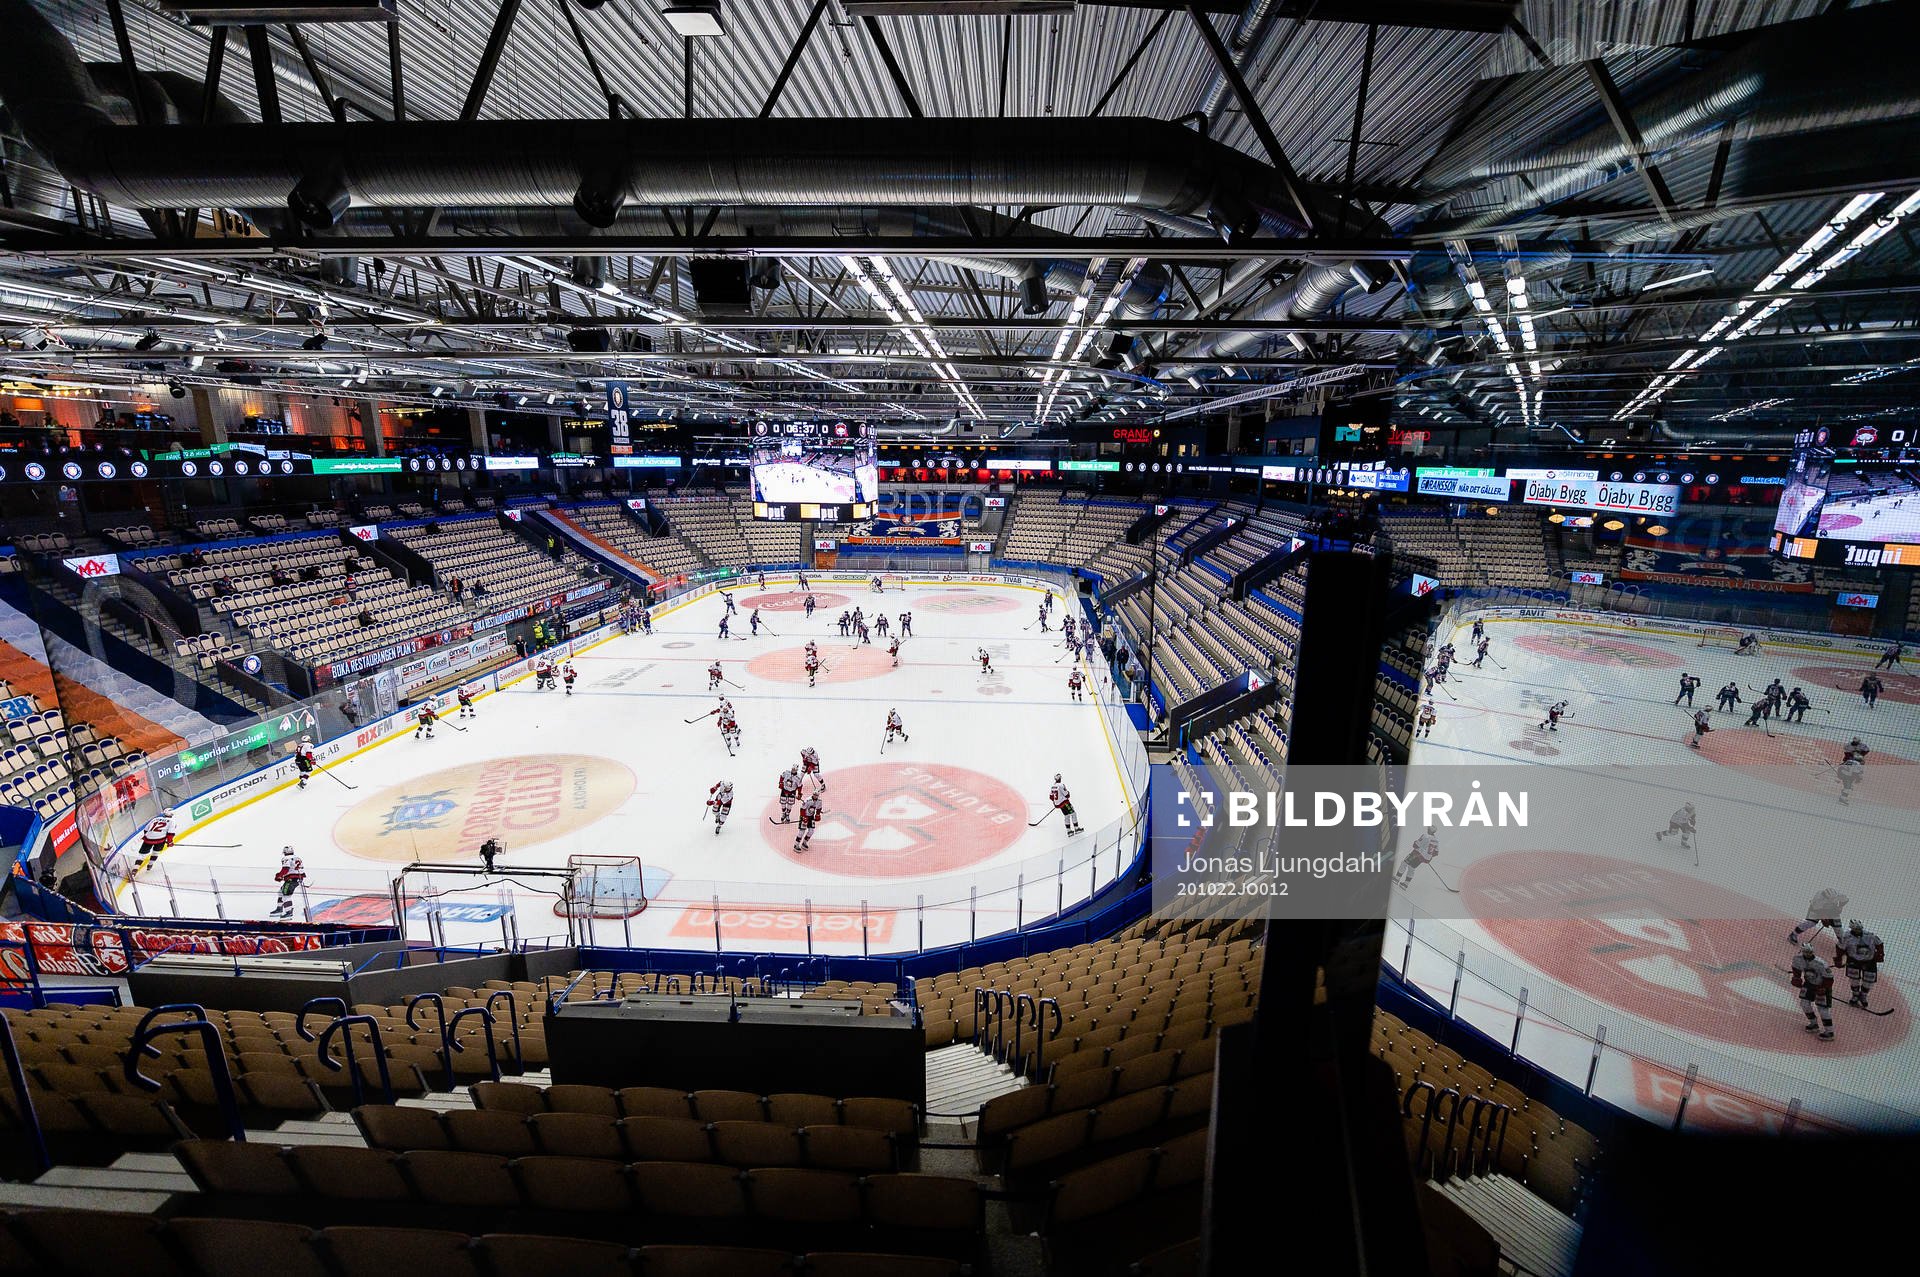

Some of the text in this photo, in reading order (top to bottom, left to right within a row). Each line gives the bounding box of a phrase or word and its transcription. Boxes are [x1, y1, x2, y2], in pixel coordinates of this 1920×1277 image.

[611, 409, 629, 437] 38
[773, 425, 780, 433] 0
[822, 425, 829, 433] 0
[1113, 429, 1150, 439] GRAND
[1458, 484, 1470, 493] NÄR
[1529, 481, 1587, 504] Öjaby Bygg
[1598, 484, 1675, 513] Öjaby Bygg
[79, 560, 108, 578] MAX
[1003, 576, 1022, 584] TIVAB
[332, 660, 350, 680] BOKA
[350, 647, 396, 673] RESTAURANGEN
[396, 643, 411, 658] PLAN
[0, 697, 33, 719] 38
[326, 742, 341, 756] AB
[157, 764, 172, 779] Din
[173, 757, 197, 776] gåva
[198, 745, 231, 766] sprider
[274, 765, 288, 781] JT
[212, 774, 268, 804] FORTNOX
[502, 762, 563, 830] GULD
[900, 765, 1014, 825] BAUHAUS
[149, 820, 168, 833] 12
[687, 911, 884, 937] betsson
